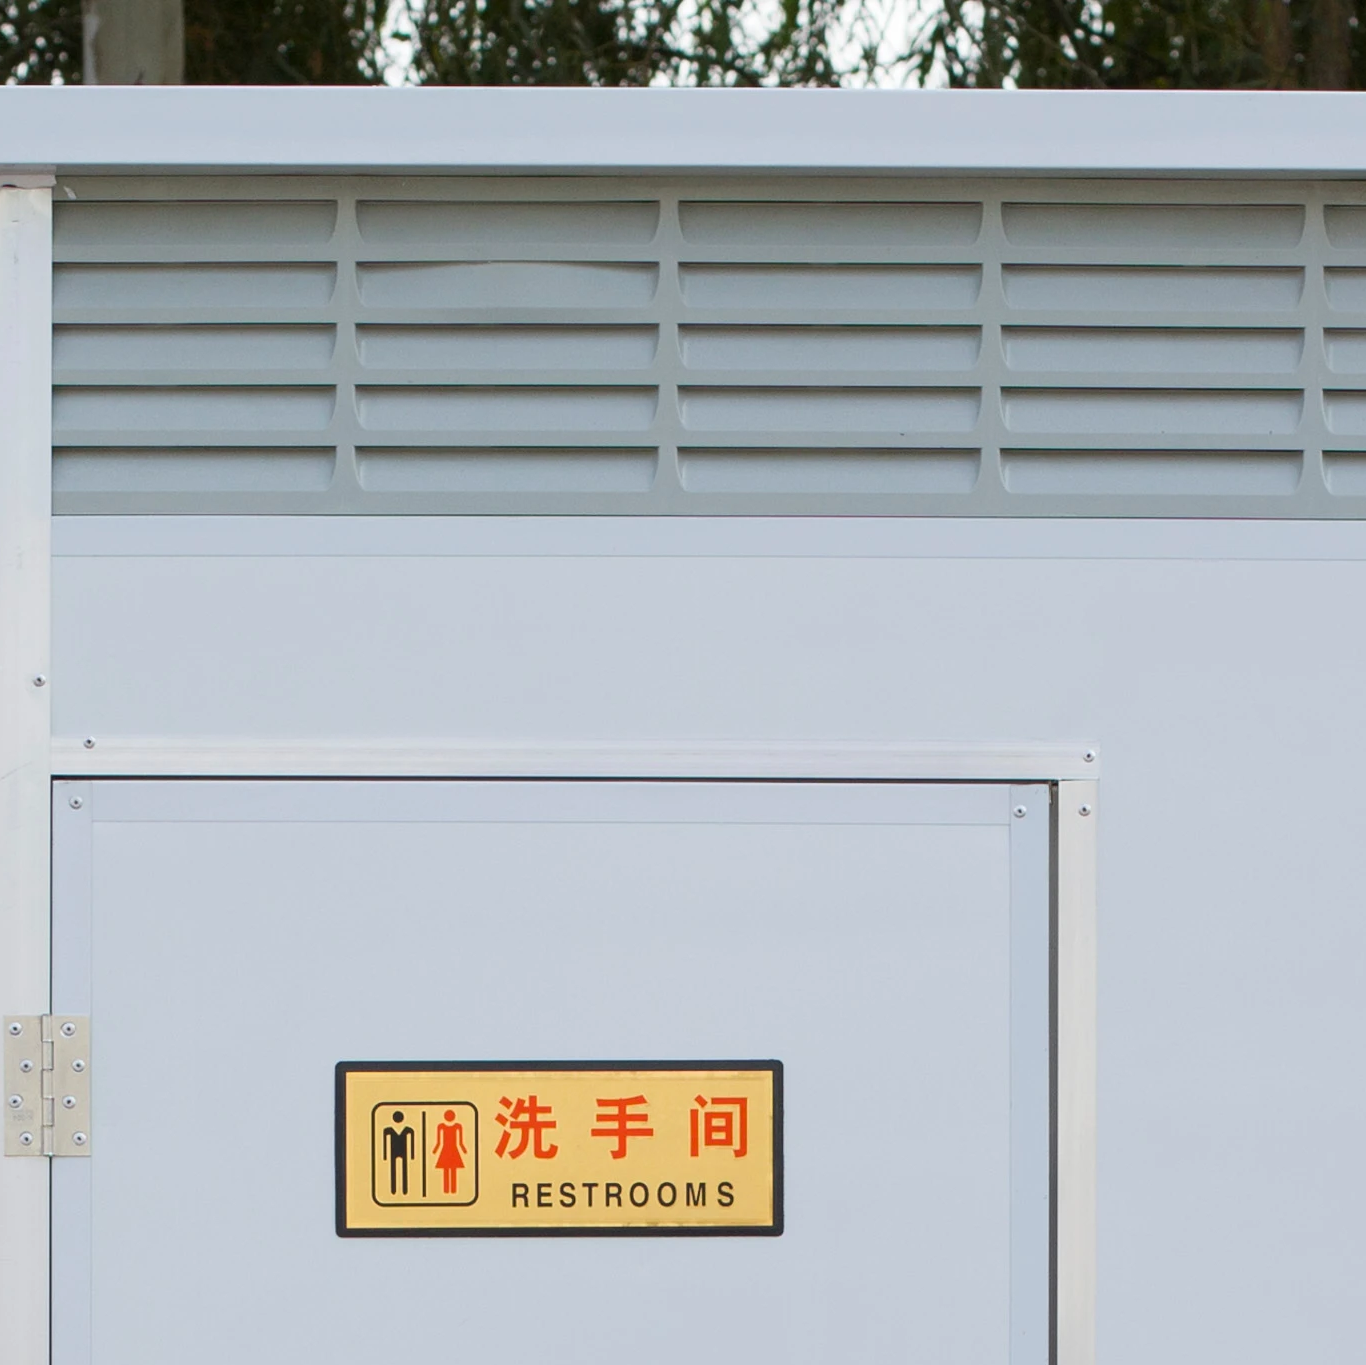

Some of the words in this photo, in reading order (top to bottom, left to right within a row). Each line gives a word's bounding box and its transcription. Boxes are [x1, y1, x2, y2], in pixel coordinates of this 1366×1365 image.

[494, 1095, 748, 1160] 洗手间
[511, 1181, 735, 1208] RESTROOMS
